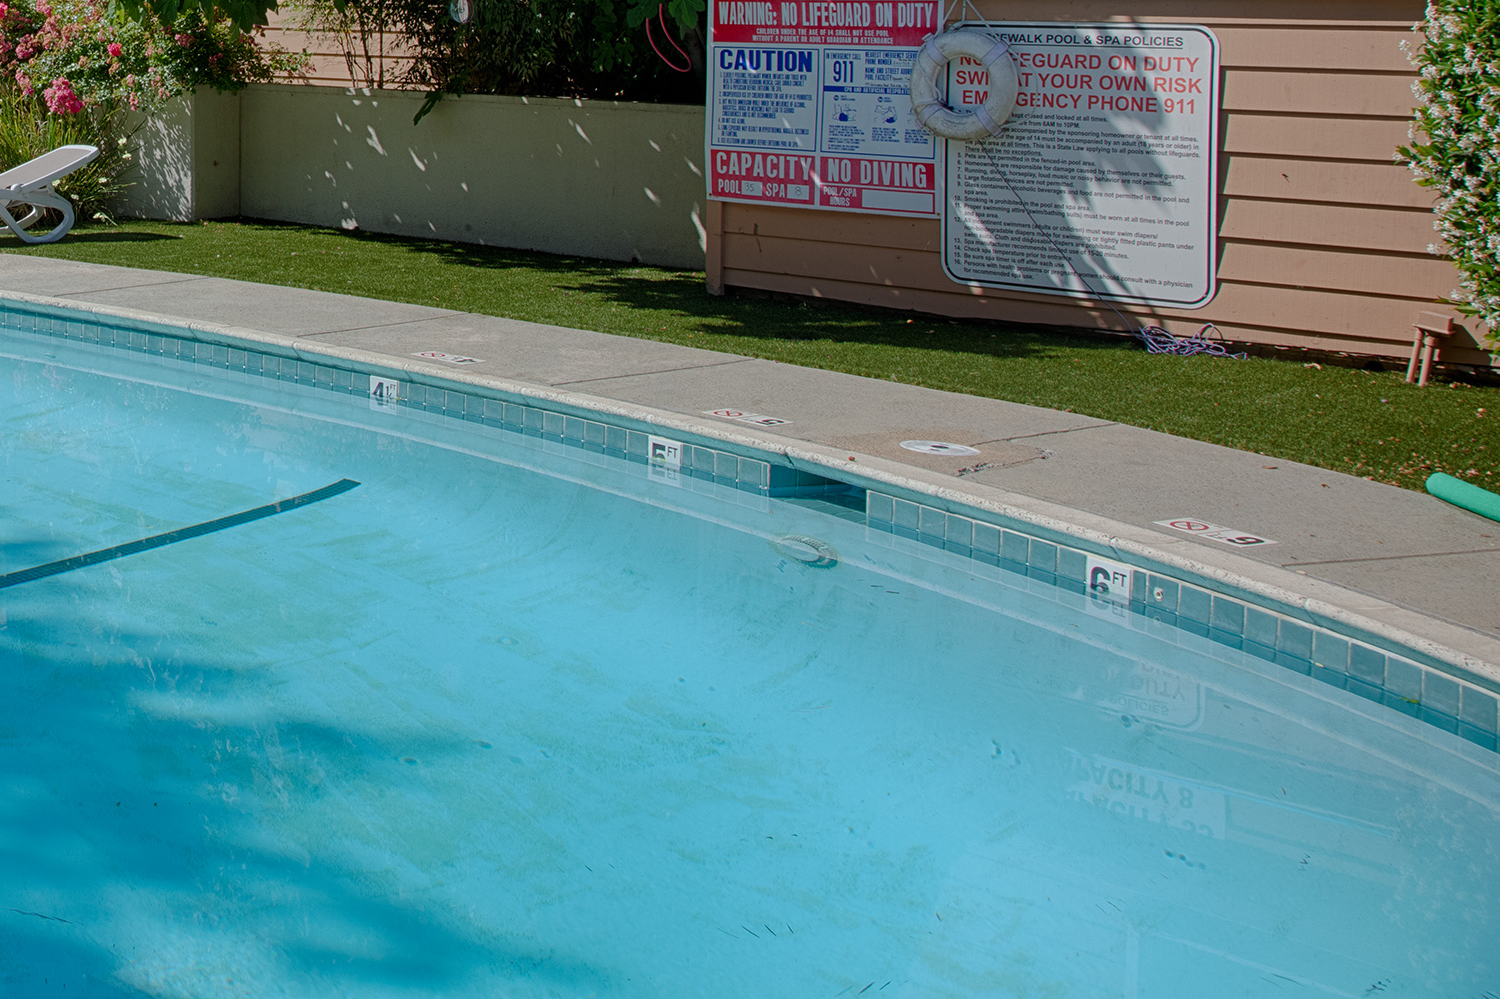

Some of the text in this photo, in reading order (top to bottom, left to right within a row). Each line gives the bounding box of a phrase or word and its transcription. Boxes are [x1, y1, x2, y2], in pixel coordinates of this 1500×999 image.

[719, 2, 933, 28] WARNING: NO LIFEGUARD ON DUTY
[986, 33, 1183, 46] EWALK POOL & SPA POLICIES
[720, 49, 812, 72] CAUTION
[1108, 55, 1136, 71] ON
[1144, 56, 1199, 72] DUTY
[833, 61, 854, 83] 911
[956, 70, 988, 85] SWI
[1038, 73, 1092, 89] YOUR
[1099, 75, 1146, 91] OWN
[1154, 77, 1202, 94] RISK
[963, 90, 1195, 114] EMGENCY PHONE 911
[1012, 127, 1047, 135] accompanied
[1068, 130, 1099, 138] sponsoring
[717, 152, 812, 181] CAPACITY
[997, 155, 1023, 163] permitted
[828, 158, 927, 188] NO DIVING
[718, 179, 802, 198] POOL 35 SPA 8
[823, 186, 857, 197] POOL/SPA
[1046, 180, 1074, 189] permitted.
[1143, 179, 1172, 188] permitted.
[830, 197, 850, 206] HOURS
[993, 249, 1024, 258] temperature
[372, 382, 384, 398] 4
[652, 442, 678, 462] 5 FT
[1091, 566, 1127, 593] 6 FT
